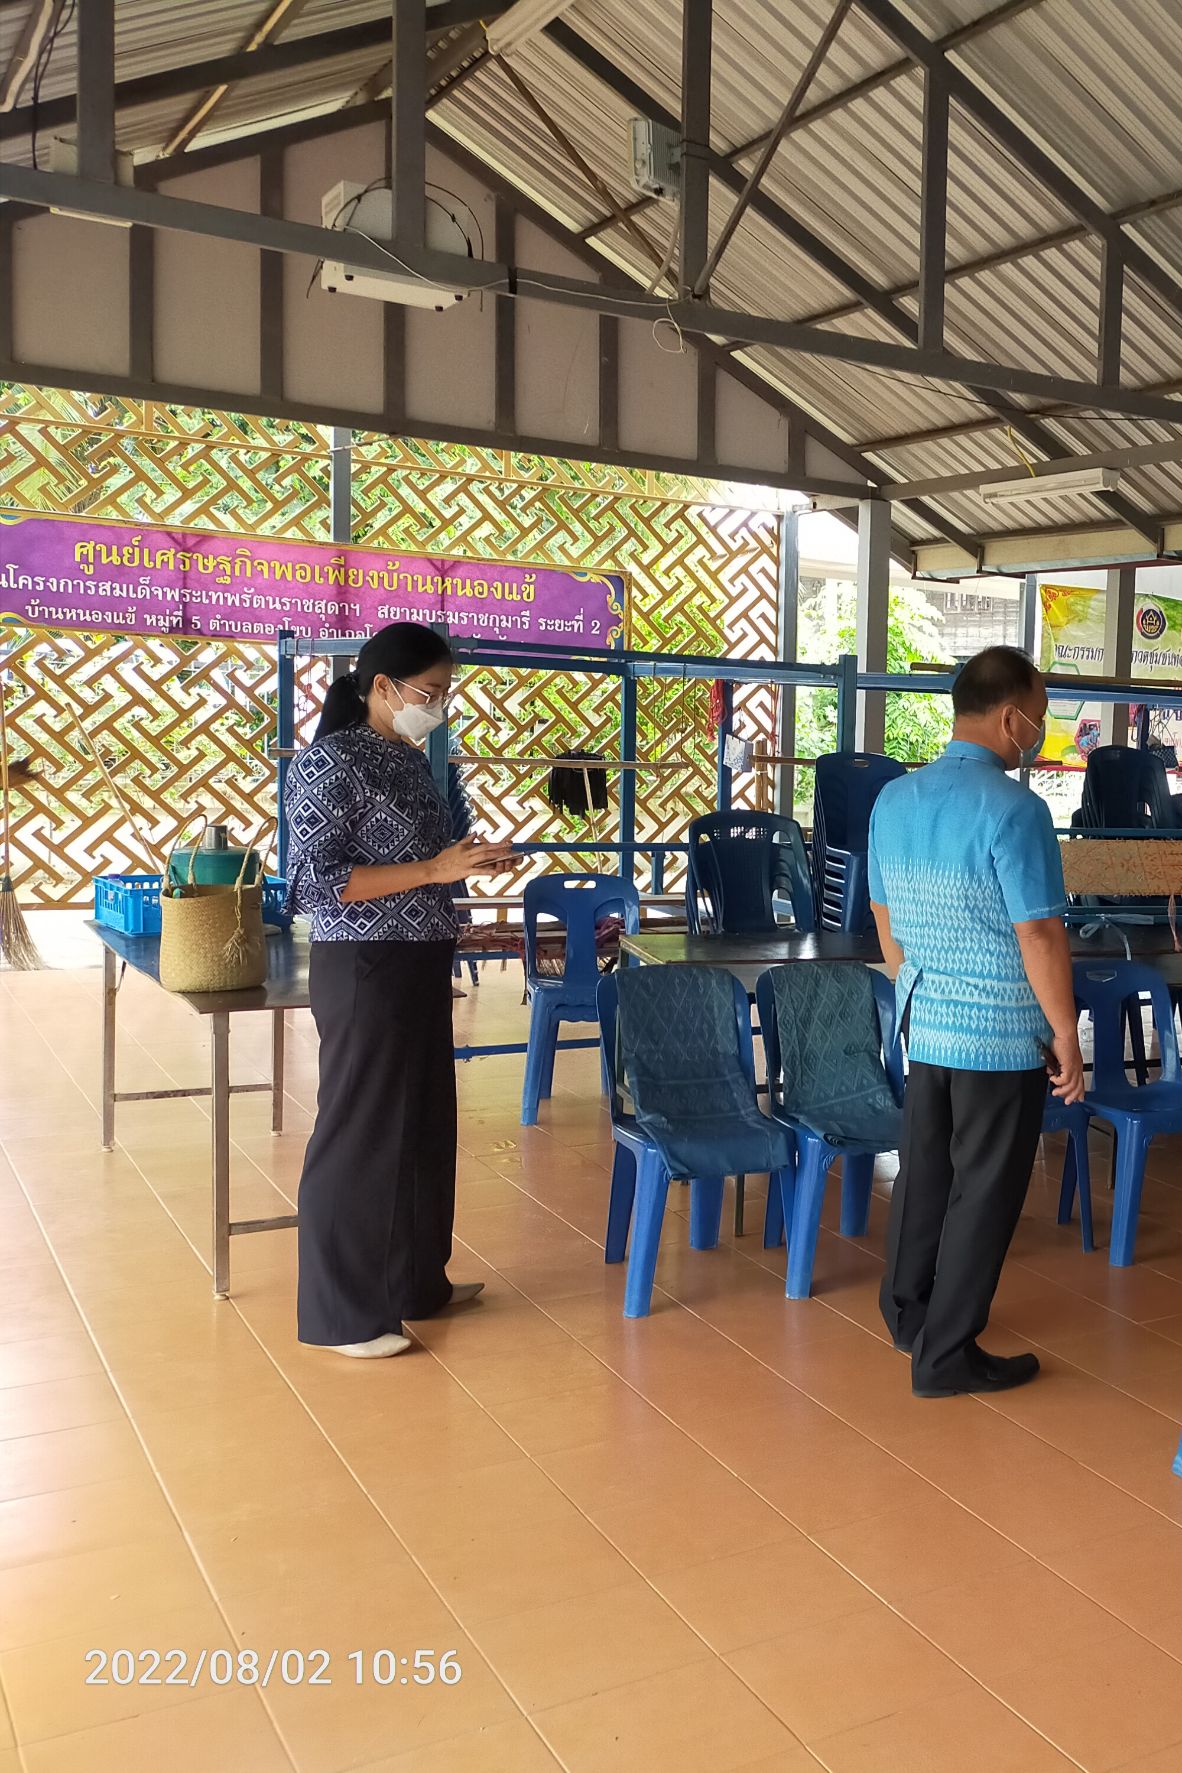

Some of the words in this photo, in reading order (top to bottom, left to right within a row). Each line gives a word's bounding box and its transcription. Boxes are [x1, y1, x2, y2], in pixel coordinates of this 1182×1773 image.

[74, 534, 536, 603] ศูนย์เศรษฐกิจพอเพียงบ้านหนองแข้
[25, 598, 136, 625] บ้านหนองแข้
[144, 605, 183, 634] หมู่ที่
[191, 615, 201, 629] 5
[378, 604, 530, 635] สยามบรมราชกุมารี
[538, 608, 584, 633] ระยะที่
[591, 619, 601, 634] 2
